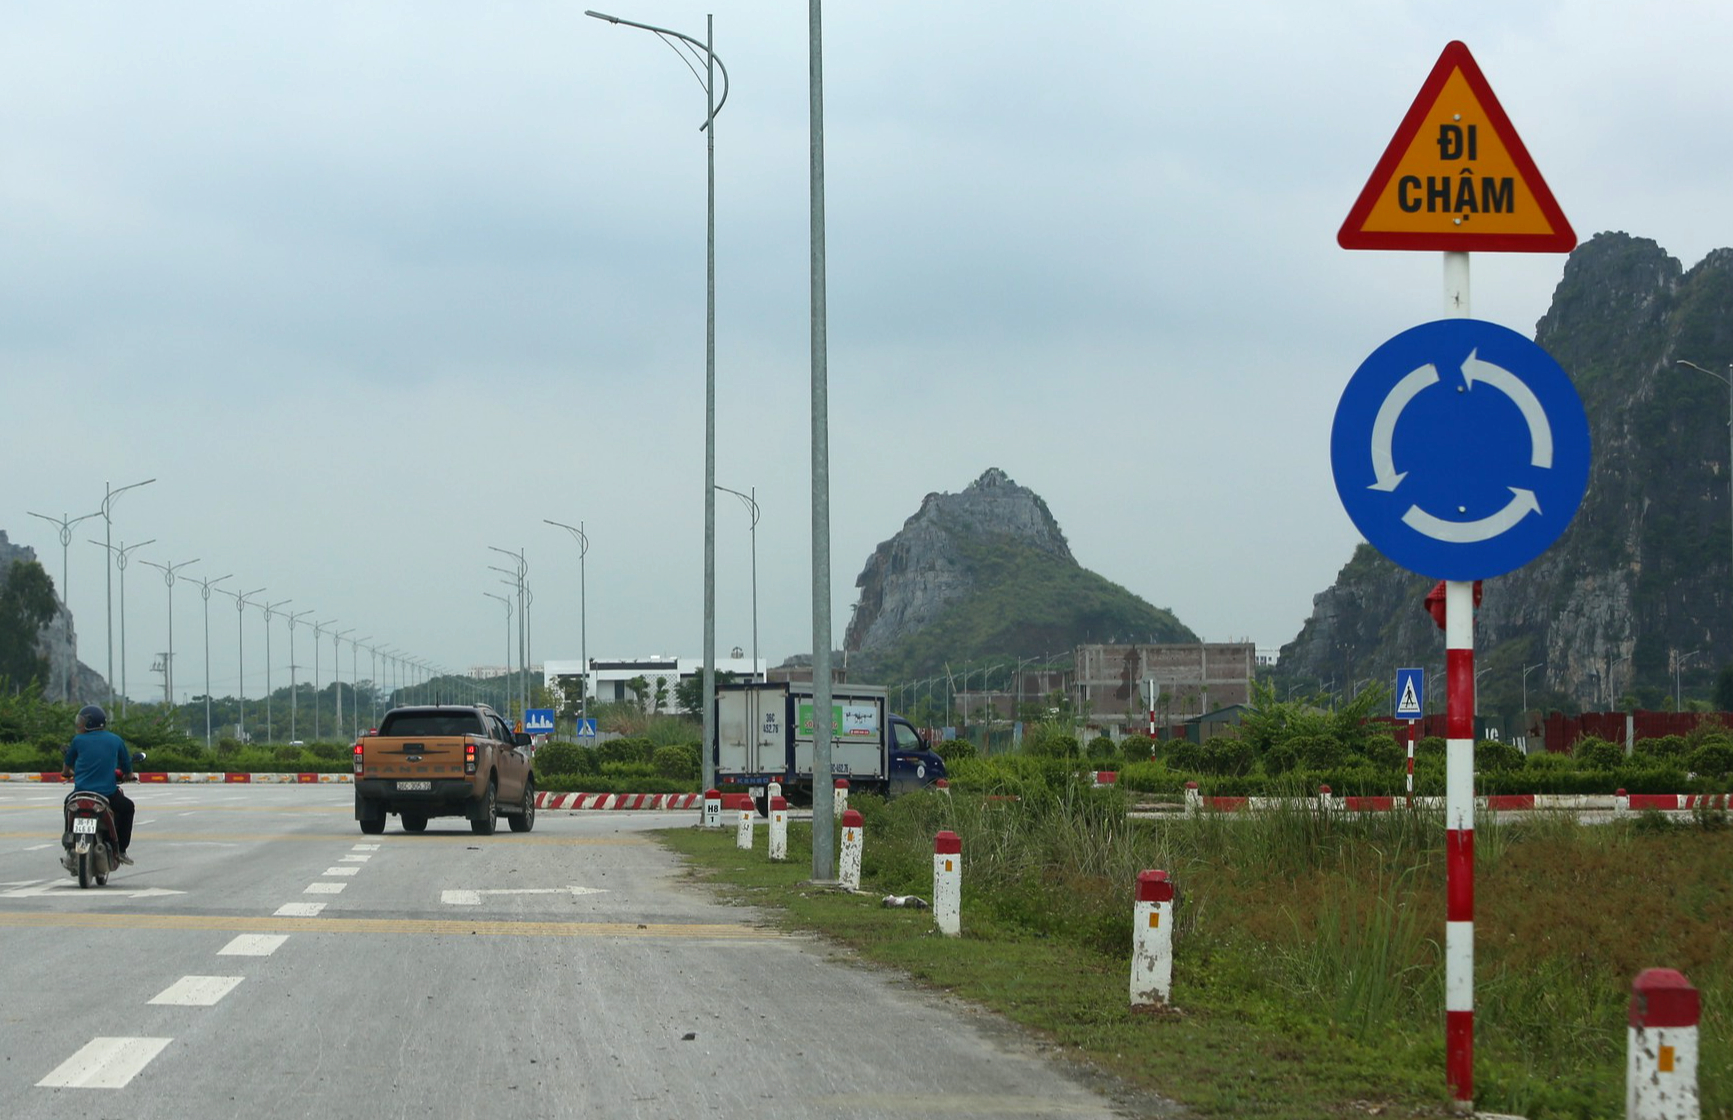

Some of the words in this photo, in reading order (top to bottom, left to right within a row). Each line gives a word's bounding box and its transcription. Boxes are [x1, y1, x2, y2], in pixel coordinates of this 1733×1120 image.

[1437, 124, 1477, 161] ĐI
[1397, 167, 1514, 221] CHẬM
[766, 713, 775, 723] 36C
[366, 765, 462, 773] RANGER
[707, 804, 719, 813] H8
